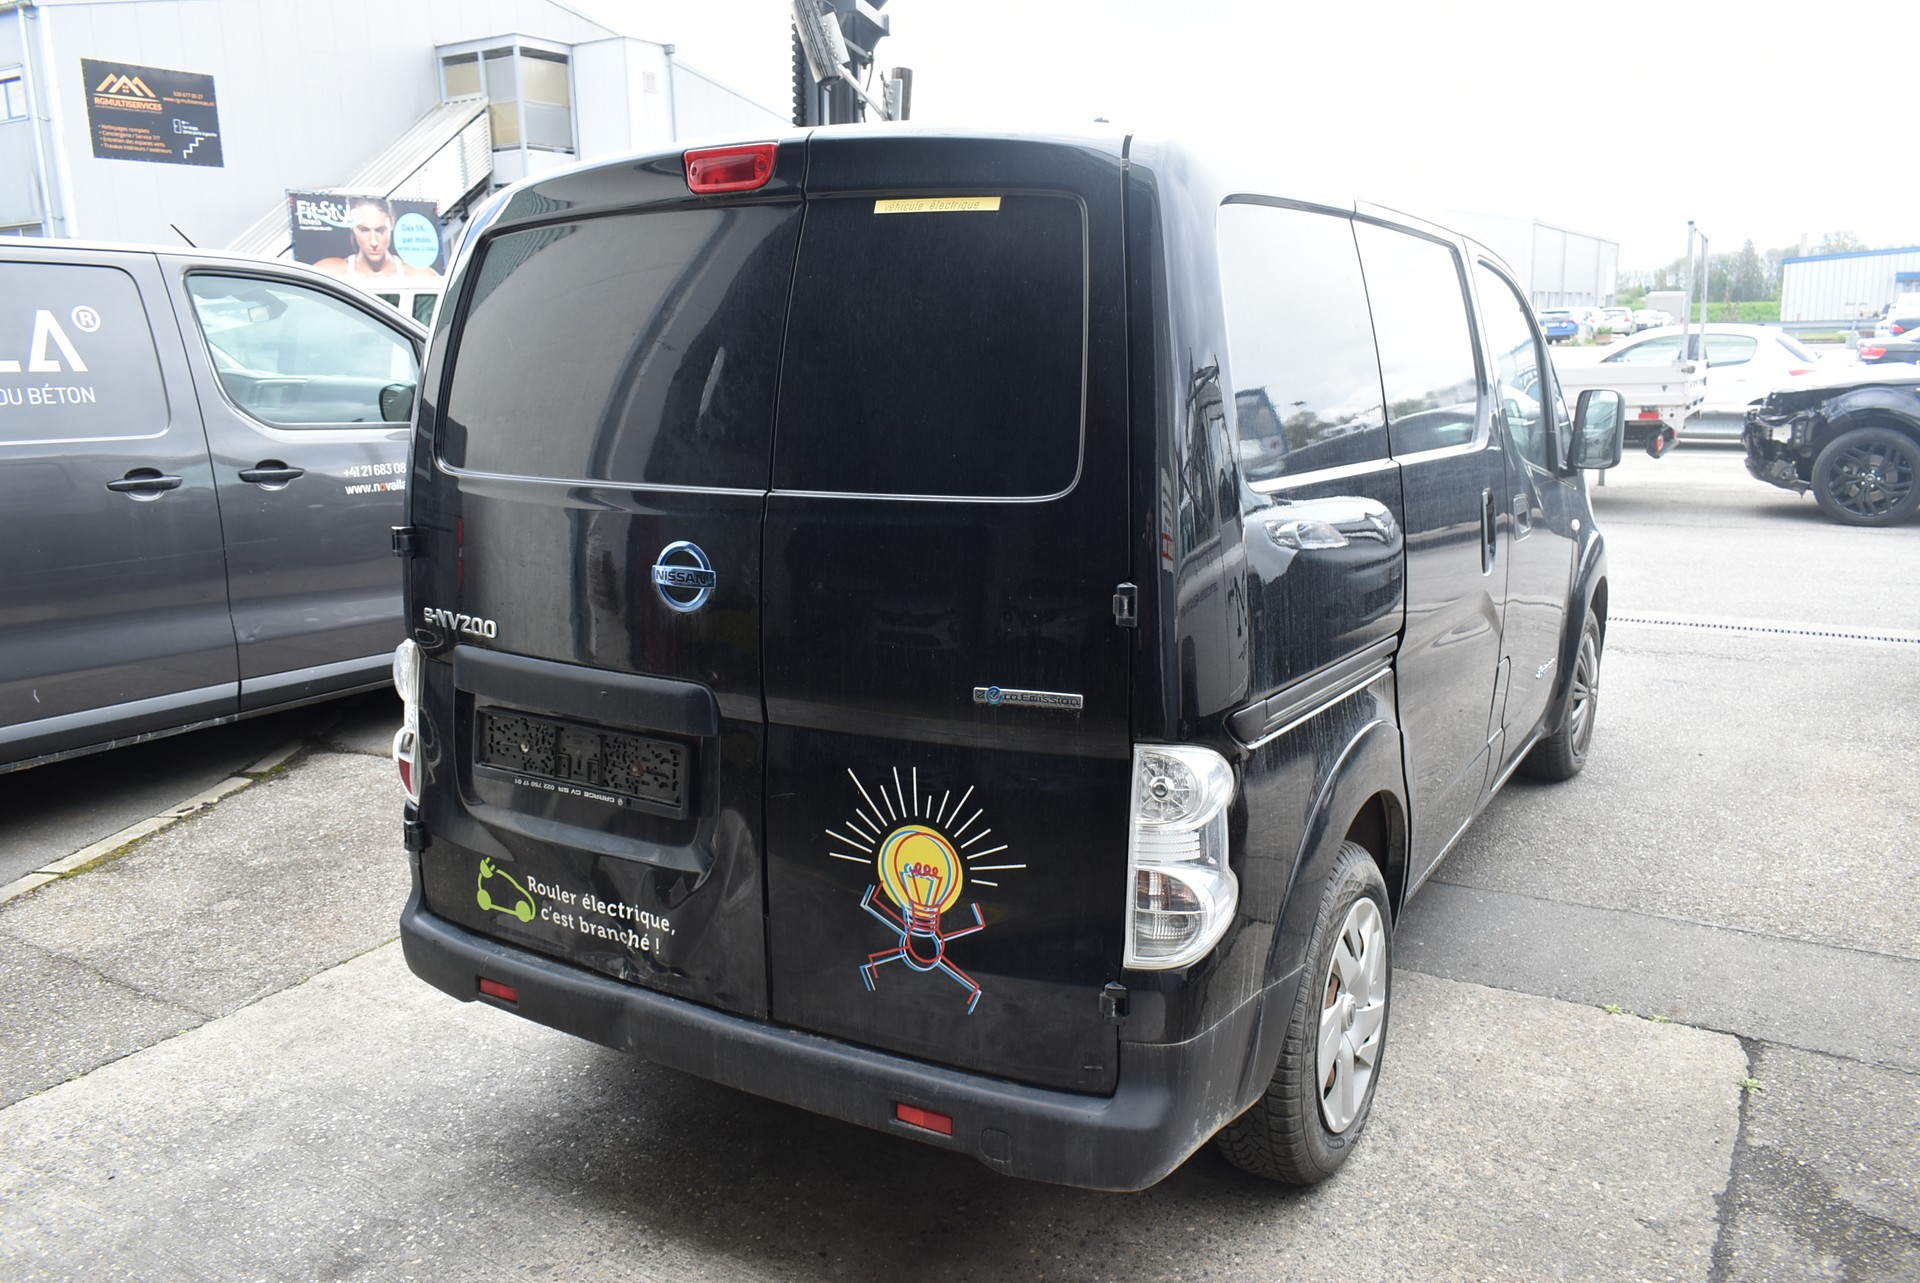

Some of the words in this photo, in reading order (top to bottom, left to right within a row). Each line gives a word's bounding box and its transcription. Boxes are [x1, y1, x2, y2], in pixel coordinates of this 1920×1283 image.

[94, 97, 163, 111] RGMULTISERVICES
[884, 201, 924, 212] véhicule
[929, 199, 980, 211] électrique
[28, 383, 96, 405] BÉTON
[344, 465, 360, 477] +41
[361, 464, 372, 477] 21
[373, 463, 392, 475] 683
[393, 462, 406, 474] 08
[656, 569, 707, 585] NISSAN
[1022, 694, 1080, 706] Emission
[543, 782, 555, 790] 022
[583, 790, 615, 803] GARAGE
[527, 875, 577, 905] Rouler
[582, 892, 676, 935] électrique,
[579, 916, 650, 951] branché
[655, 937, 660, 954] !
